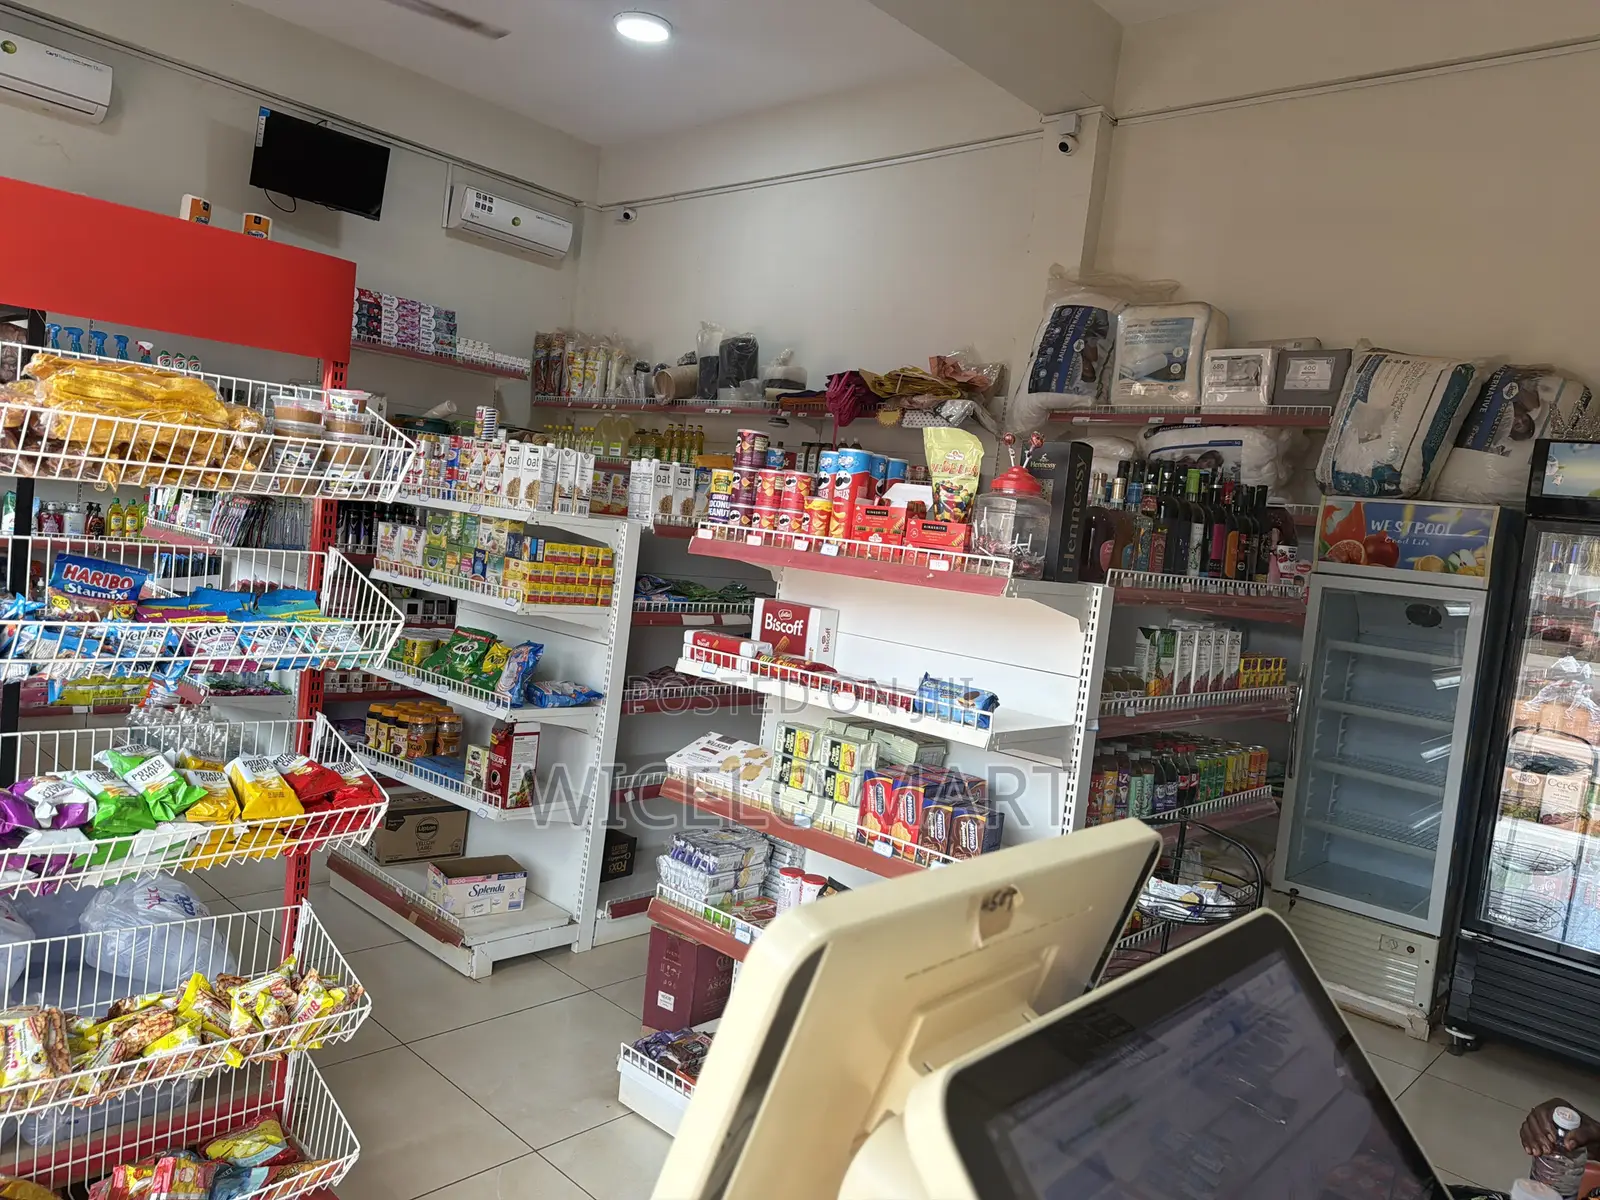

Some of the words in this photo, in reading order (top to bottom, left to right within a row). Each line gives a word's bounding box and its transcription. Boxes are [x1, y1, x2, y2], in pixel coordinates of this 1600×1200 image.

[1030, 461, 1057, 470] Hennessy
[1062, 455, 1087, 572] Hennessy
[1371, 519, 1451, 537] WESTPOOL
[62, 563, 134, 590] HARIBO
[67, 582, 127, 602] Starmix
[764, 613, 804, 637] Biscoff
[823, 627, 832, 653] Biscoff
[132, 758, 162, 781] POTATO
[242, 757, 270, 768] POTATO
[250, 763, 274, 774] CHIPS
[140, 764, 165, 783] CHIPS
[194, 770, 223, 778] POTATO
[1547, 777, 1580, 793] Ceres
[418, 824, 437, 833] Lipton
[468, 883, 506, 898] Splenda
